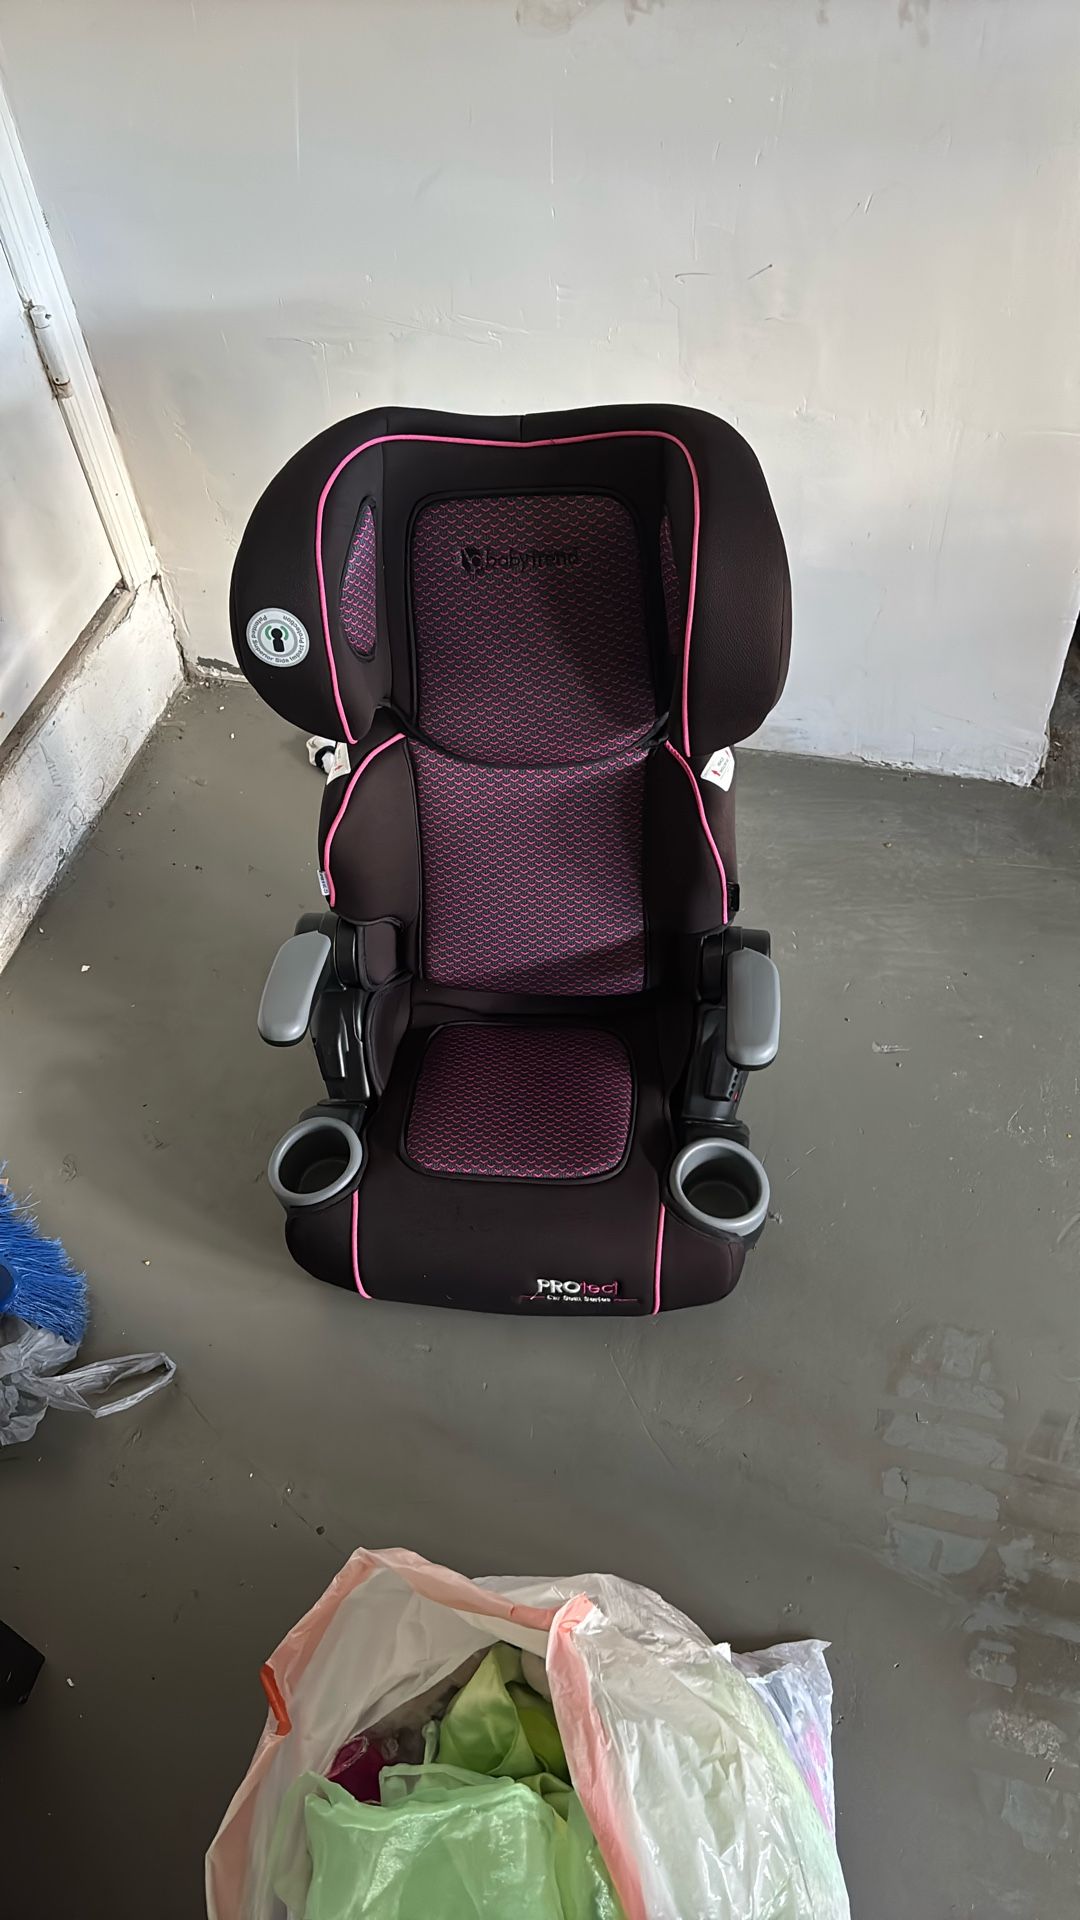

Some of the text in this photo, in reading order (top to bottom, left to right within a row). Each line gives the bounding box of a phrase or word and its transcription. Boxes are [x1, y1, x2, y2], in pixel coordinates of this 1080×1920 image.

[282, 615, 305, 644] Protection
[252, 639, 275, 661] Superior
[289, 644, 305, 661] Impact
